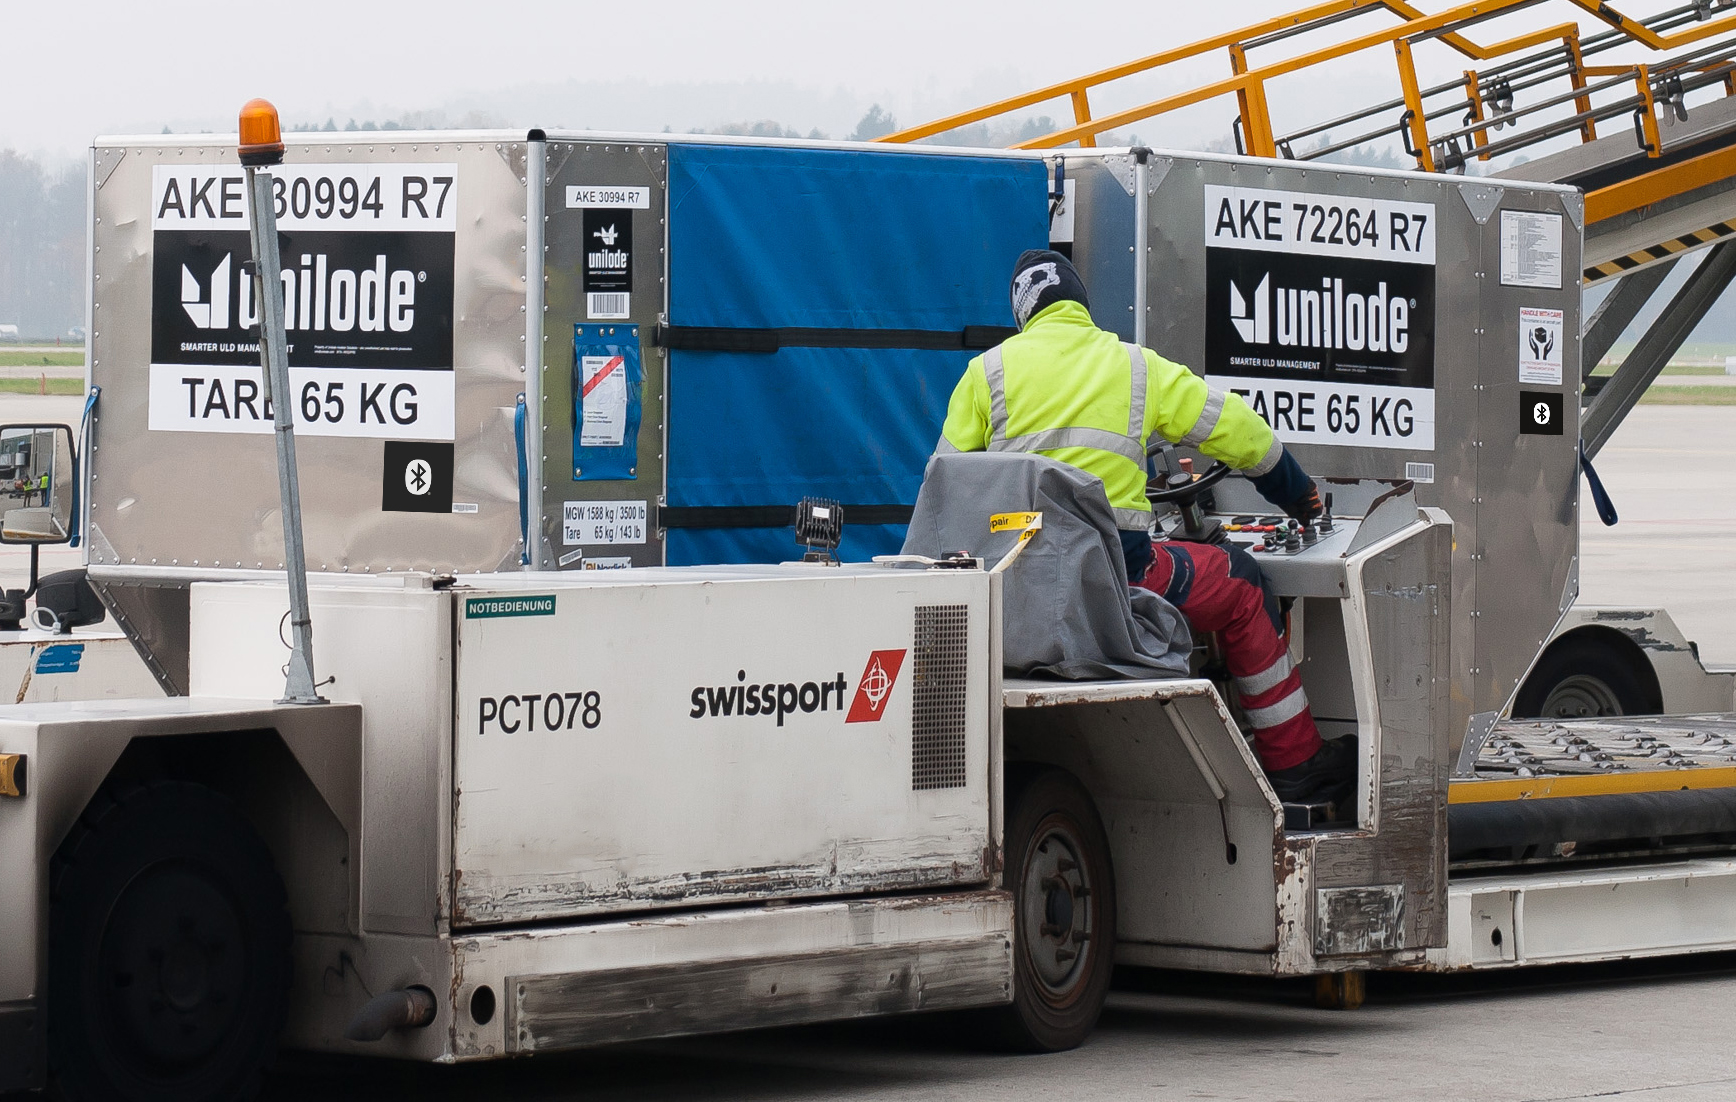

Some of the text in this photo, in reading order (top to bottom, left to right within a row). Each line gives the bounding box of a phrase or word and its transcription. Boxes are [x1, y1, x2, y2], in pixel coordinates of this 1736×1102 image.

[157, 176, 453, 219] AKE 30994 R7
[575, 190, 640, 203] AKE 30994 R7
[1214, 197, 1427, 253] AKE 72264 R7
[588, 248, 627, 269] unilode
[1276, 276, 1409, 353] unilode
[180, 342, 217, 352] SMARTER
[219, 343, 236, 352] ULD
[1230, 356, 1321, 370] SMARTER ULD MANAGEMENT
[181, 377, 418, 426] TAR 65 KG
[1326, 393, 1360, 435] 65
[1371, 396, 1414, 438] KG
[565, 506, 585, 520] MGW
[587, 506, 604, 520] 1588
[605, 506, 614, 523] kg
[620, 506, 637, 520] 3500
[638, 505, 645, 519] lb
[565, 526, 581, 539] Tare
[594, 526, 603, 539] 65
[605, 526, 614, 543] kg
[620, 525, 632, 539] 143
[634, 525, 641, 539] lb
[468, 599, 553, 614] NOTBEDIENUNG
[689, 669, 847, 727] swissport
